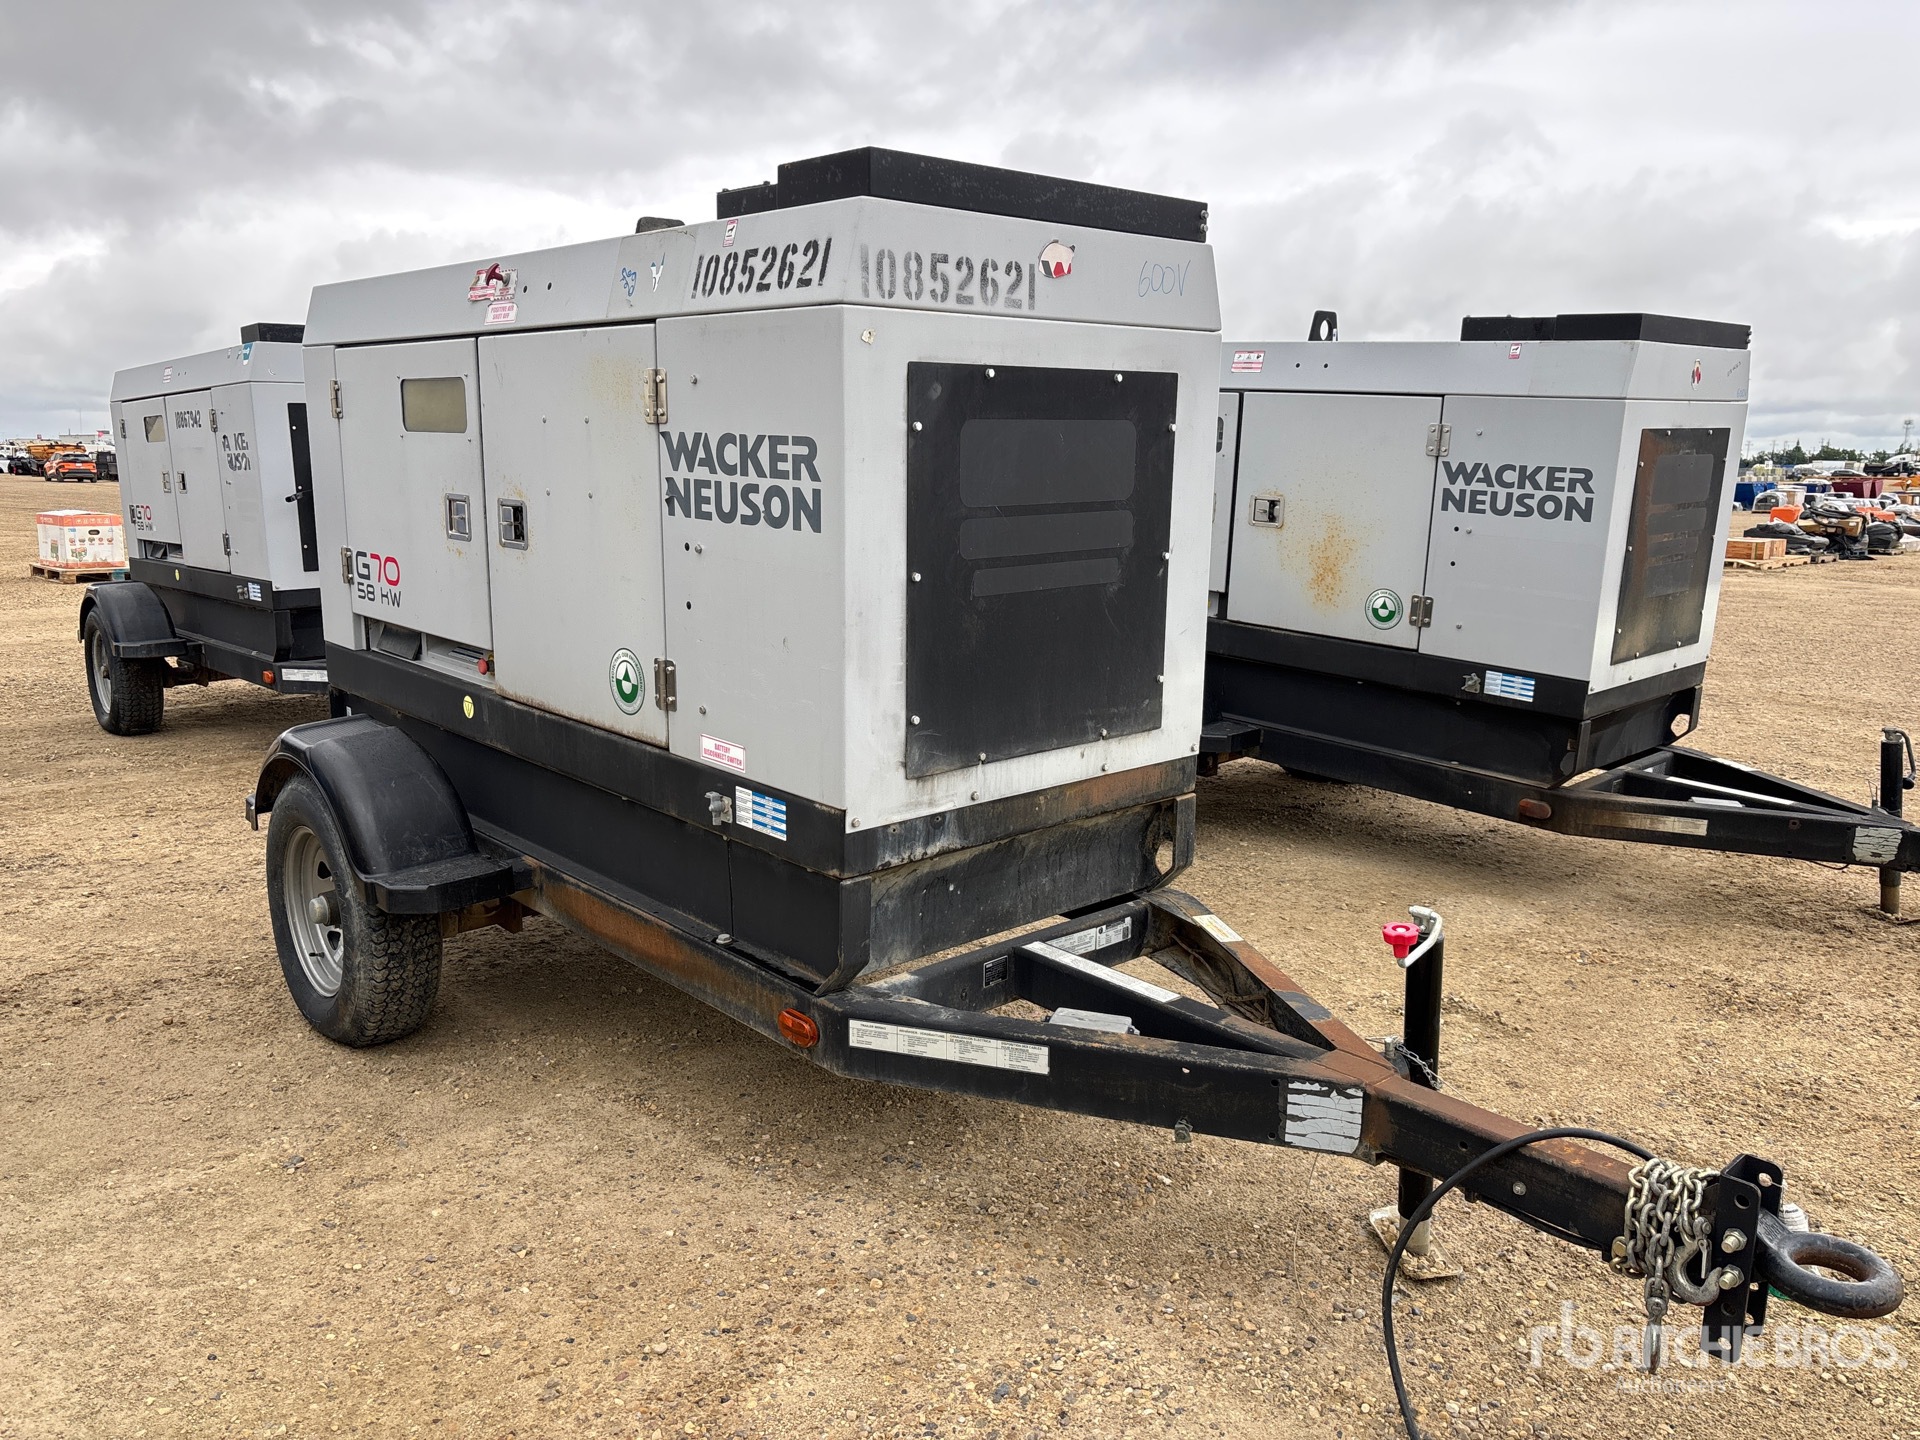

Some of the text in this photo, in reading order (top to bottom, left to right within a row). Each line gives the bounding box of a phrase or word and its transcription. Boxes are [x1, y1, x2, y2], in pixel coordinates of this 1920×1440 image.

[691, 237, 832, 299] 10852621
[860, 243, 1036, 311] 10852621
[1138, 260, 1192, 297] 600V
[174, 409, 201, 429] 10867942
[659, 431, 822, 482] WACKER
[1442, 460, 1595, 494] WACKER
[136, 505, 152, 520] G70
[664, 477, 822, 533] NEUSON
[1441, 487, 1594, 523] NEUSON
[356, 550, 400, 586] G70
[357, 582, 375, 602] 58
[703, 747, 742, 766] DISCONNECT SWITCH
[714, 743, 731, 754] BATTERY
